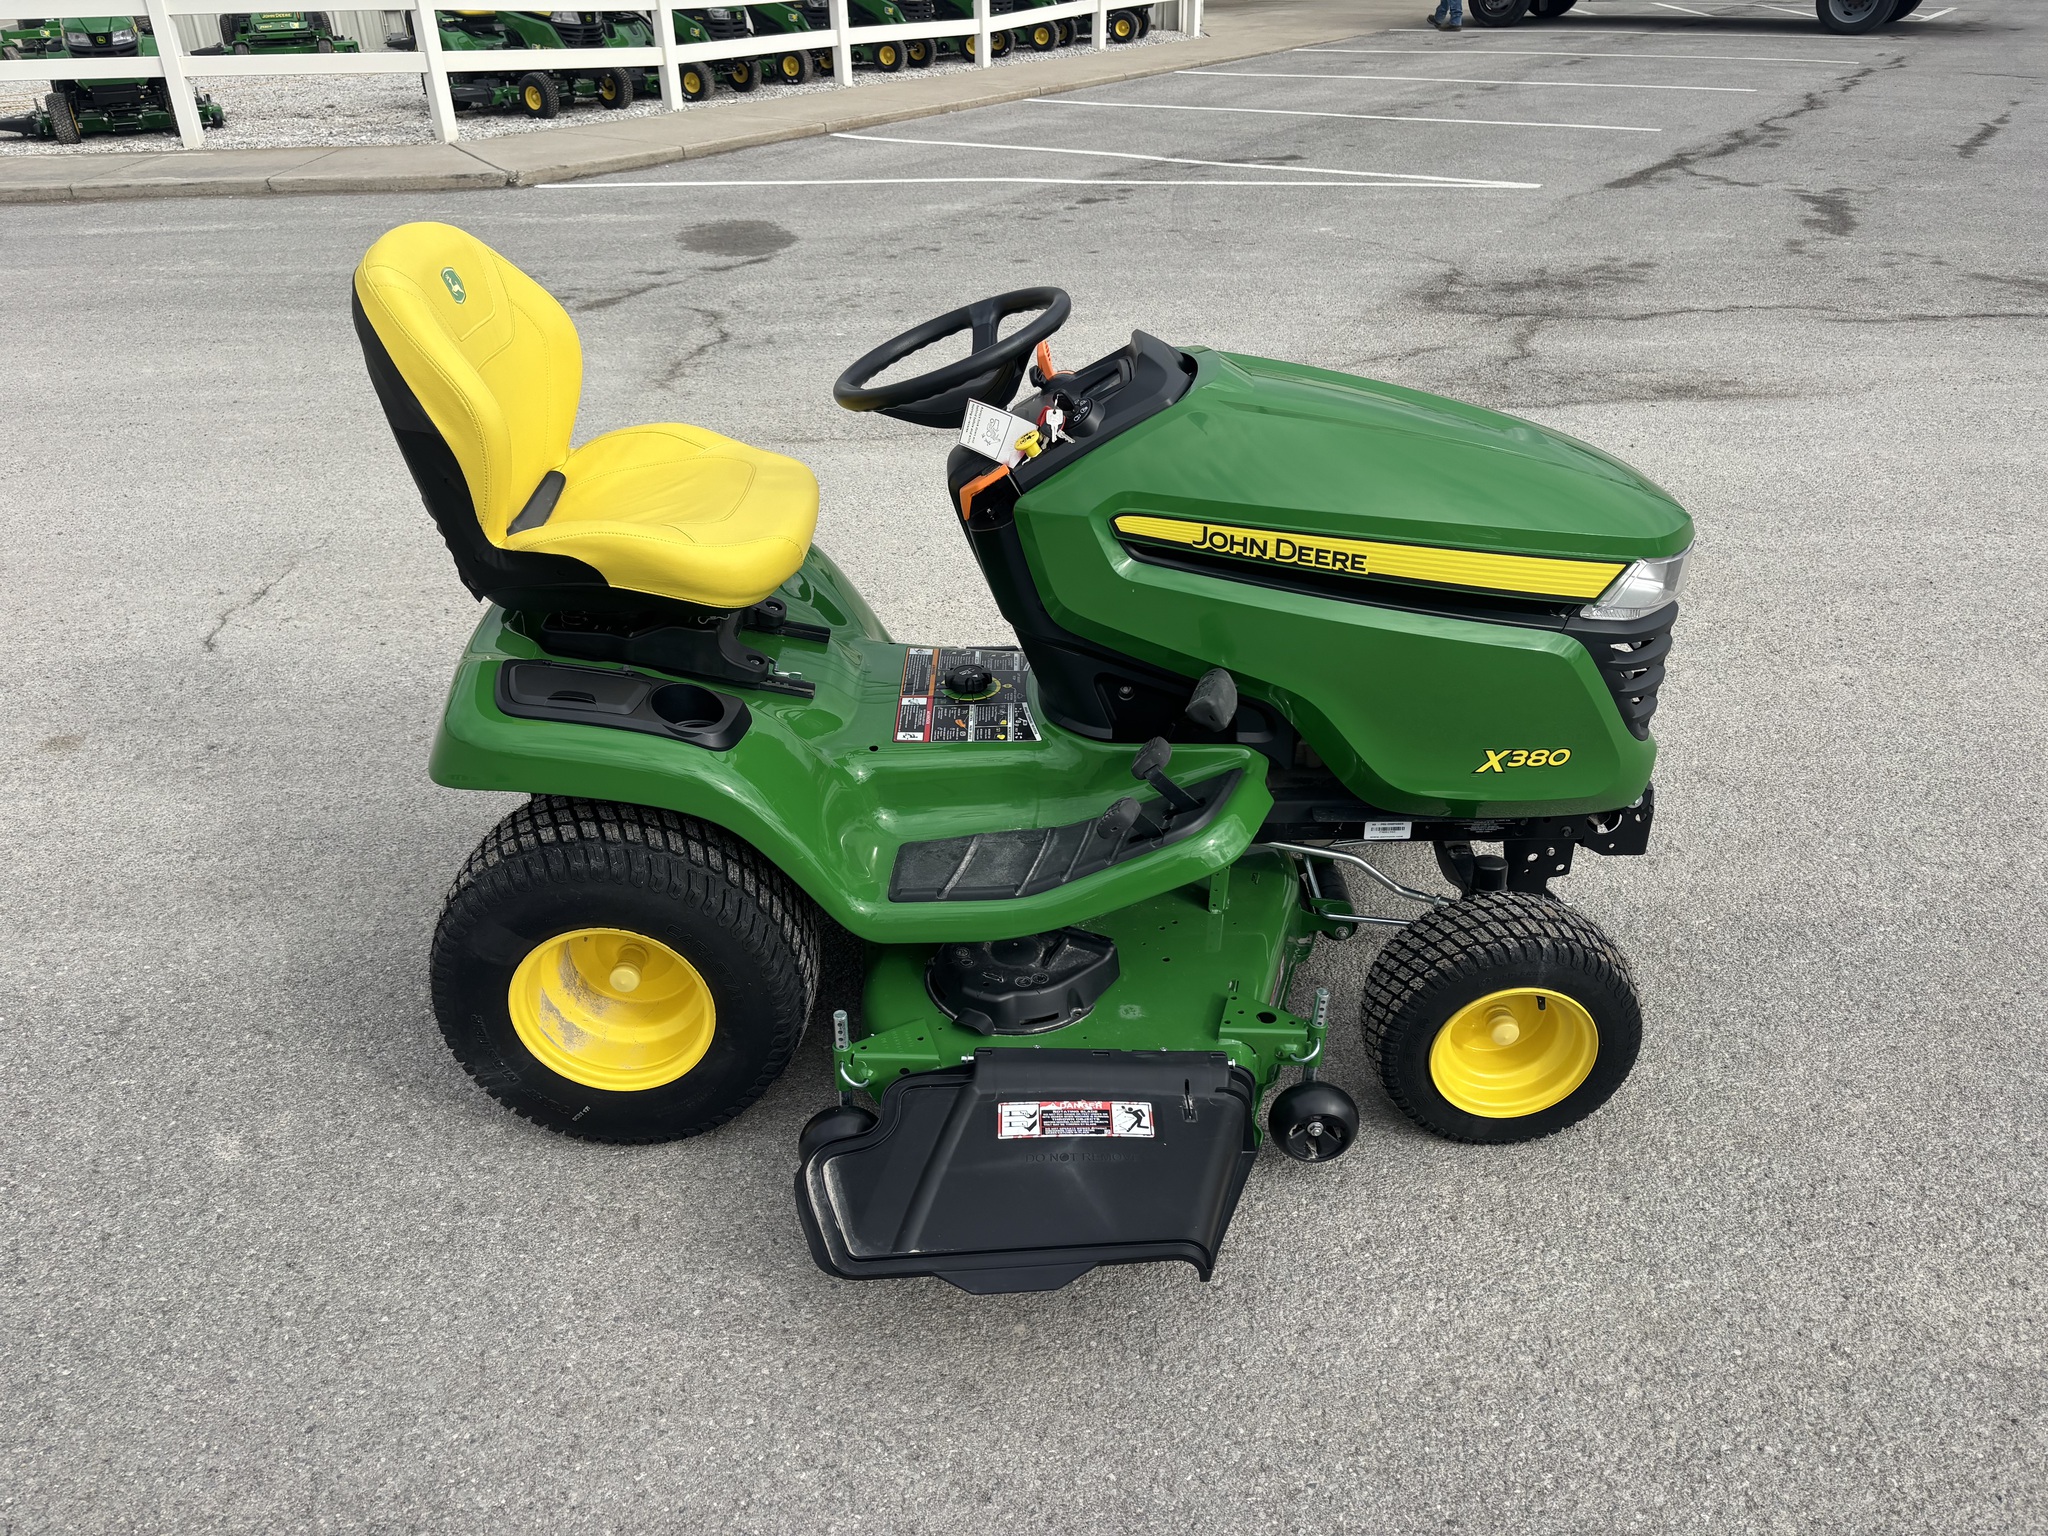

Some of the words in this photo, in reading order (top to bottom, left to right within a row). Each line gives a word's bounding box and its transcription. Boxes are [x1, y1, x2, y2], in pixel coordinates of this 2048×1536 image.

[1192, 526, 1268, 557] JOHN
[1275, 538, 1367, 572] DEERE
[1471, 748, 1572, 773] X380
[1059, 1101, 1103, 1109] DANGER
[1025, 1153, 1046, 1163] DO
[1049, 1152, 1078, 1162] NOT
